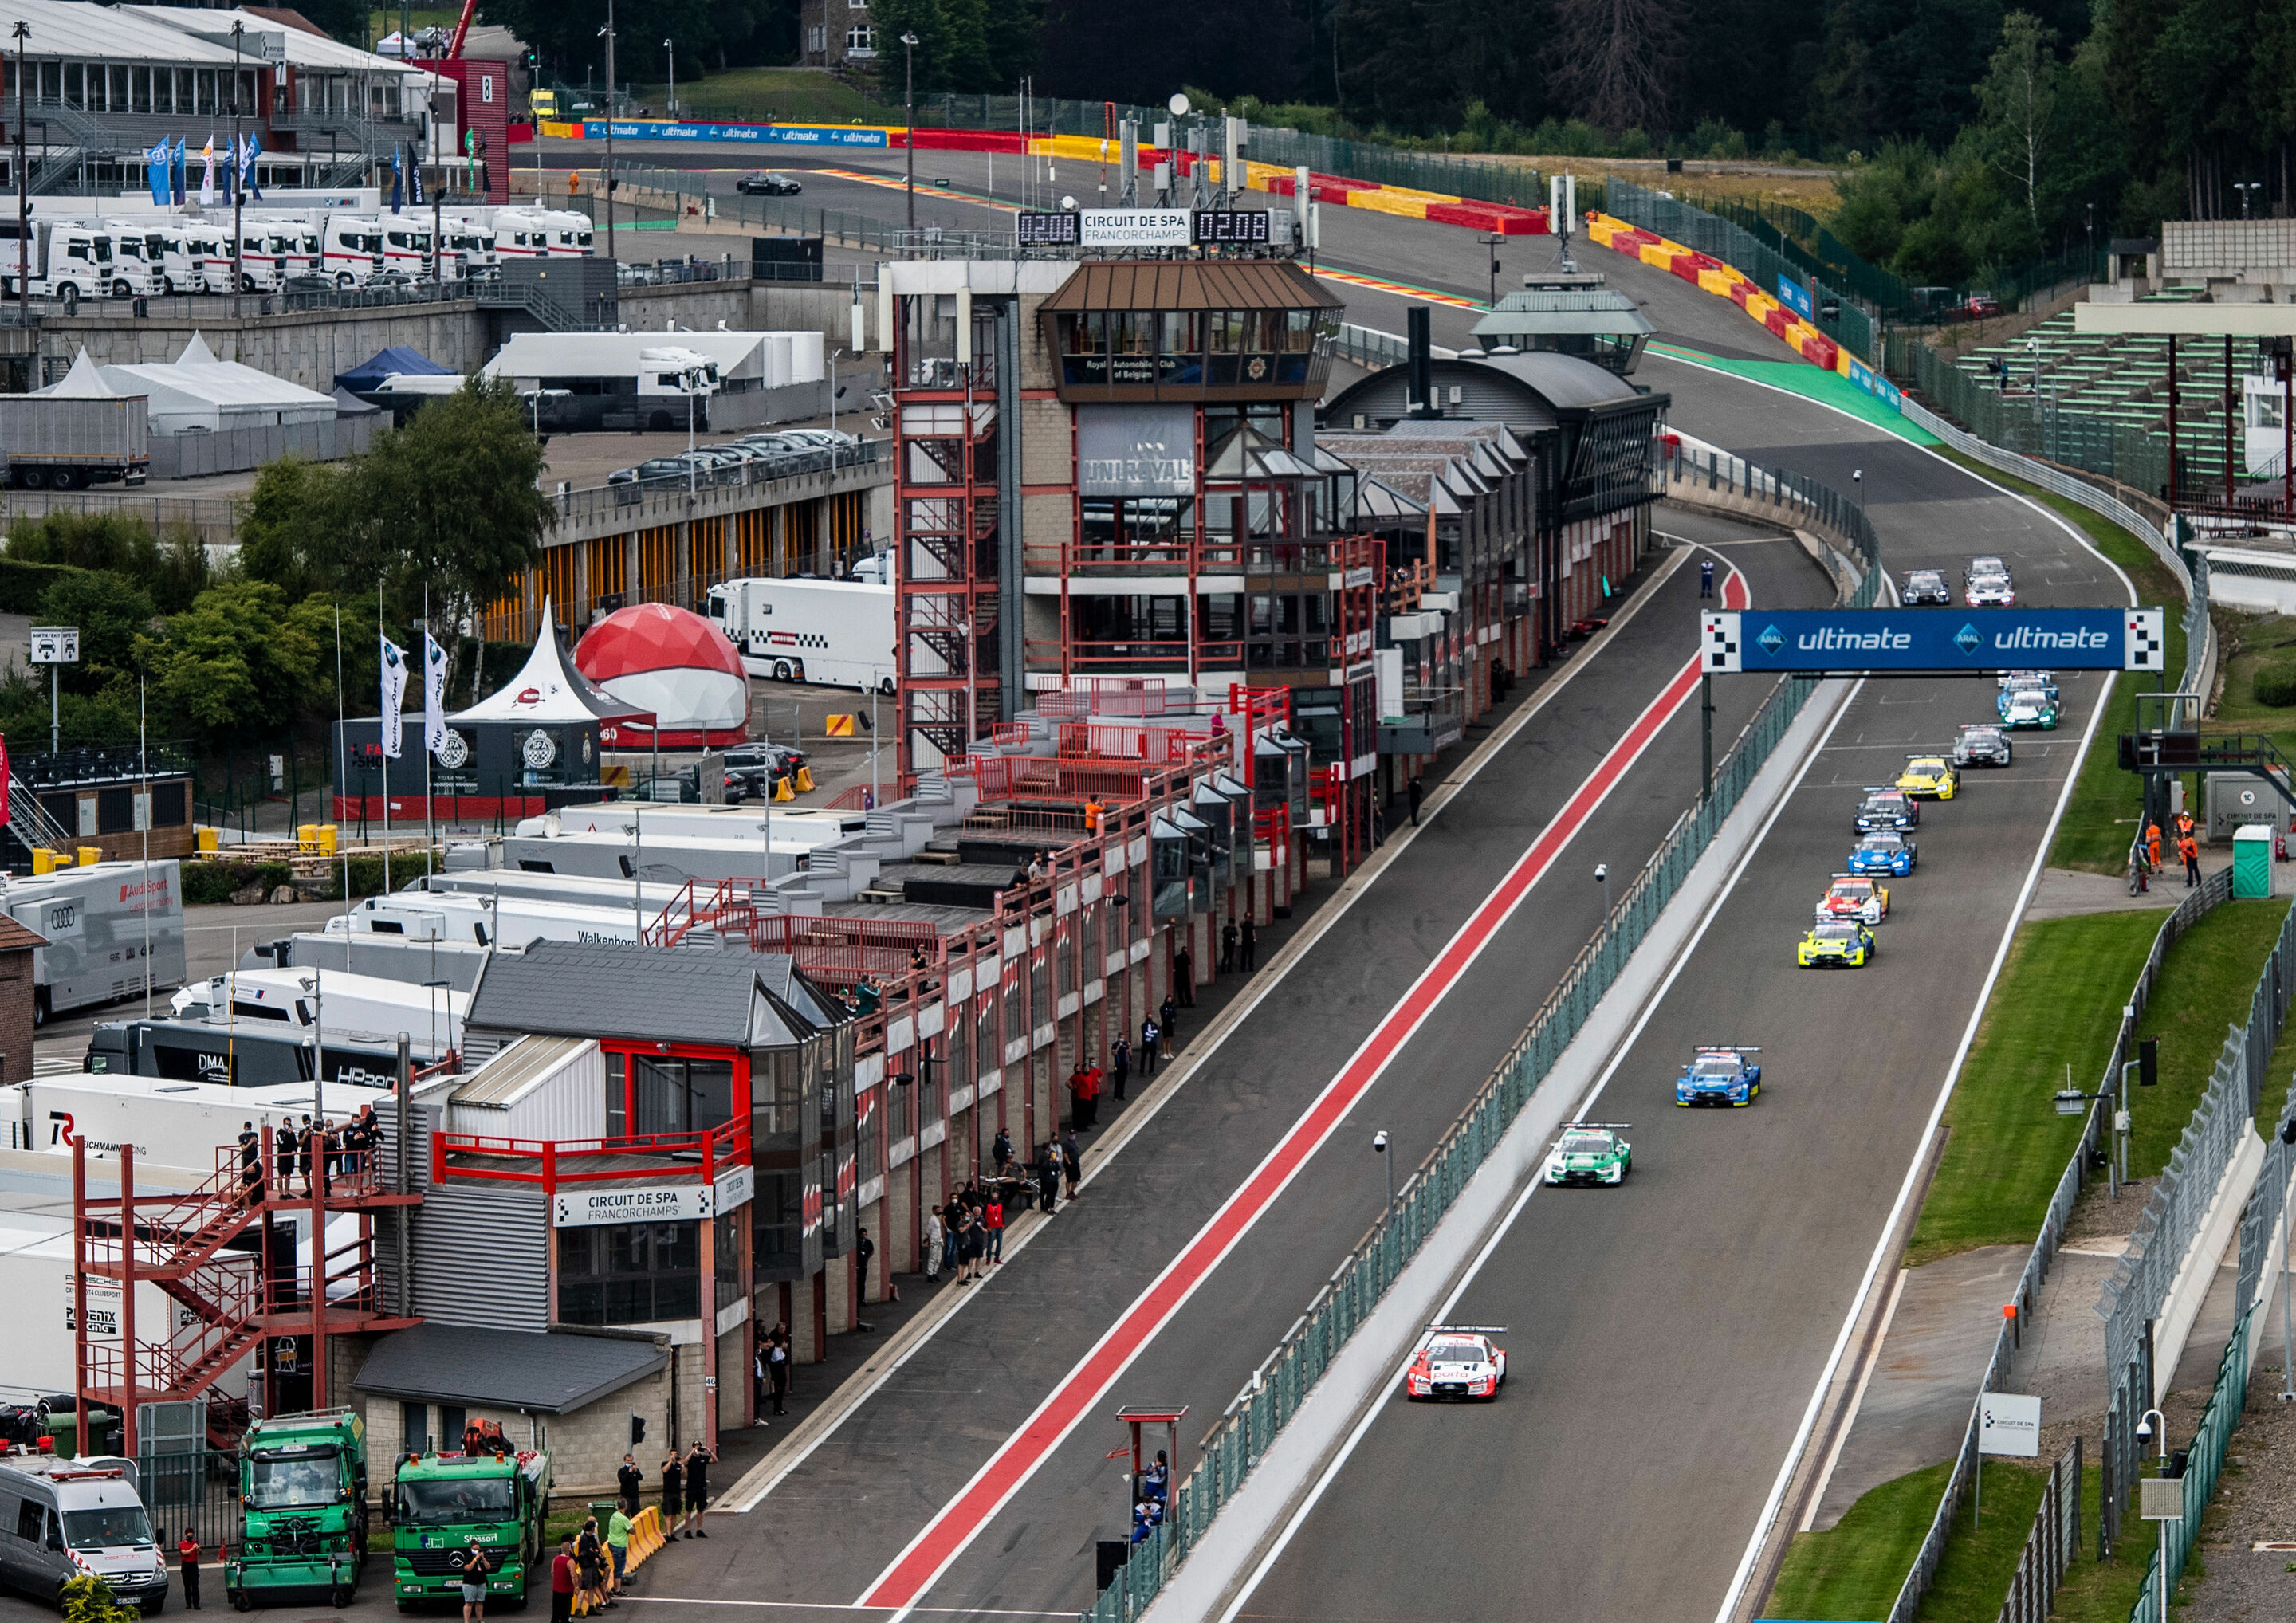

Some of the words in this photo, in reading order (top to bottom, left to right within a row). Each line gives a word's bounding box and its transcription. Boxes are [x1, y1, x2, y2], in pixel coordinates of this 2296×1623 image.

[276, 61, 284, 83] 7
[485, 78, 490, 100] 8
[603, 125, 639, 136] utimate
[662, 126, 698, 137] ultimate
[722, 128, 757, 138] ultimate
[782, 130, 818, 141] ultimate
[843, 132, 880, 143] ultimate
[1085, 216, 1137, 226] CIRCUIT
[1140, 216, 1156, 226] DE
[1161, 216, 1185, 226] SPA
[1085, 230, 1186, 240] FRANCORCHAMPS
[1087, 360, 1107, 369] Royal
[1114, 370, 1122, 379] of
[1122, 370, 1153, 379] Belgium
[1798, 627, 1912, 650] ultimate
[1995, 626, 2109, 649] ultimate
[366, 744, 383, 755] FA
[532, 741, 547, 749] SPA
[147, 879, 167, 894] Sport
[588, 1195, 635, 1208] CIRCUIT
[638, 1193, 653, 1205] DE
[655, 1192, 678, 1204] SPA
[588, 1205, 680, 1220] FRANCORCHAMPS
[95, 1289, 121, 1299] CLUBSPORT
[1433, 1370, 1468, 1381] porta
